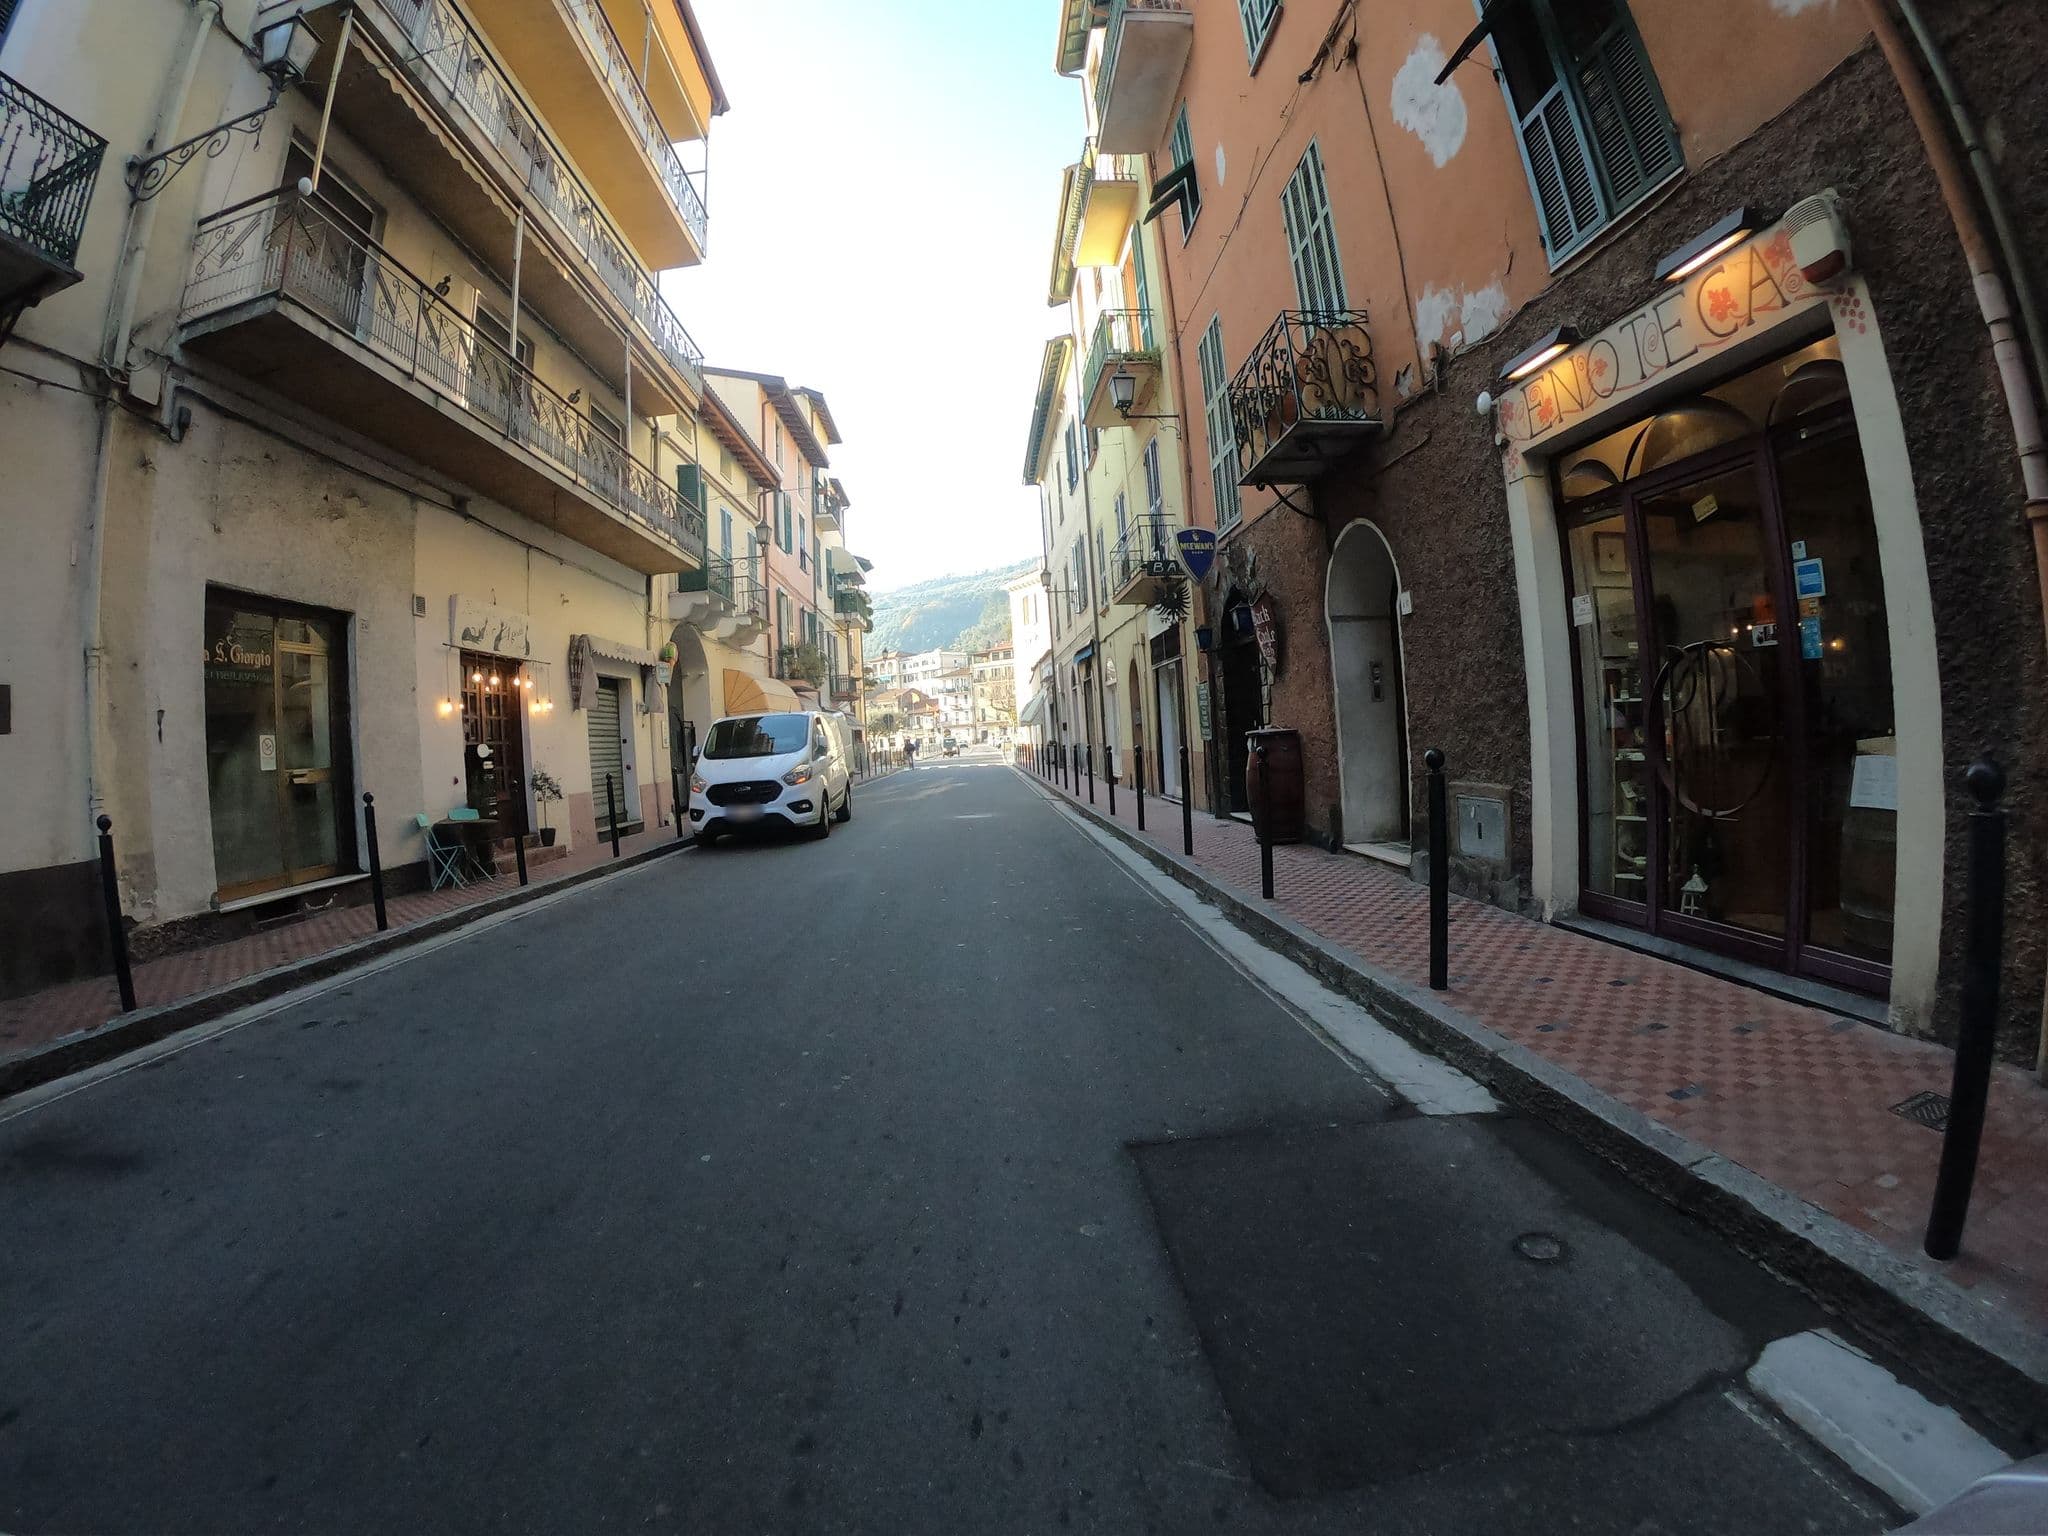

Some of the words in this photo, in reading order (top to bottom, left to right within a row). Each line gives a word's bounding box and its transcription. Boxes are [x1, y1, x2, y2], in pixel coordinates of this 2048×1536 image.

[1520, 245, 1791, 439] ENOTECA
[1153, 562, 1177, 573] BA
[229, 640, 271, 669] Giorgio
